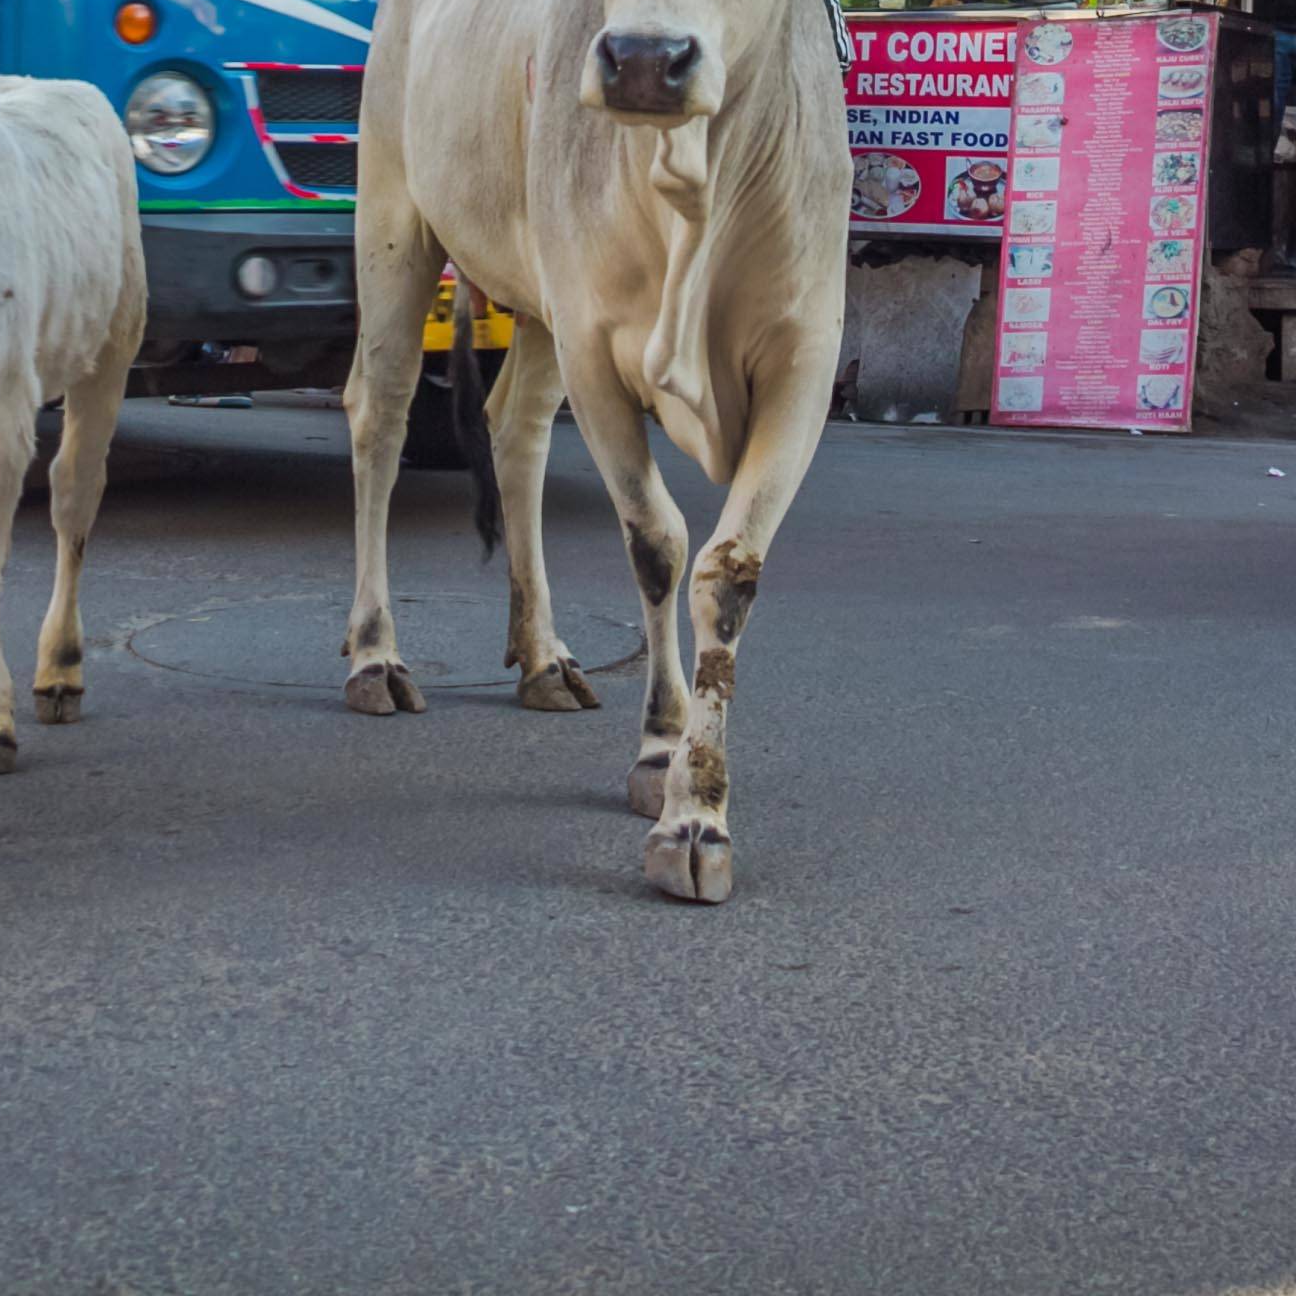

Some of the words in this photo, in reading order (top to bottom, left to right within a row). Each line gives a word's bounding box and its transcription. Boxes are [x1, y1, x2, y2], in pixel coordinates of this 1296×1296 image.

[857, 72, 1013, 97] RESTAURAN
[884, 110, 960, 125] INDIAN
[891, 132, 943, 146] FAST
[950, 132, 1009, 148] FOOD
